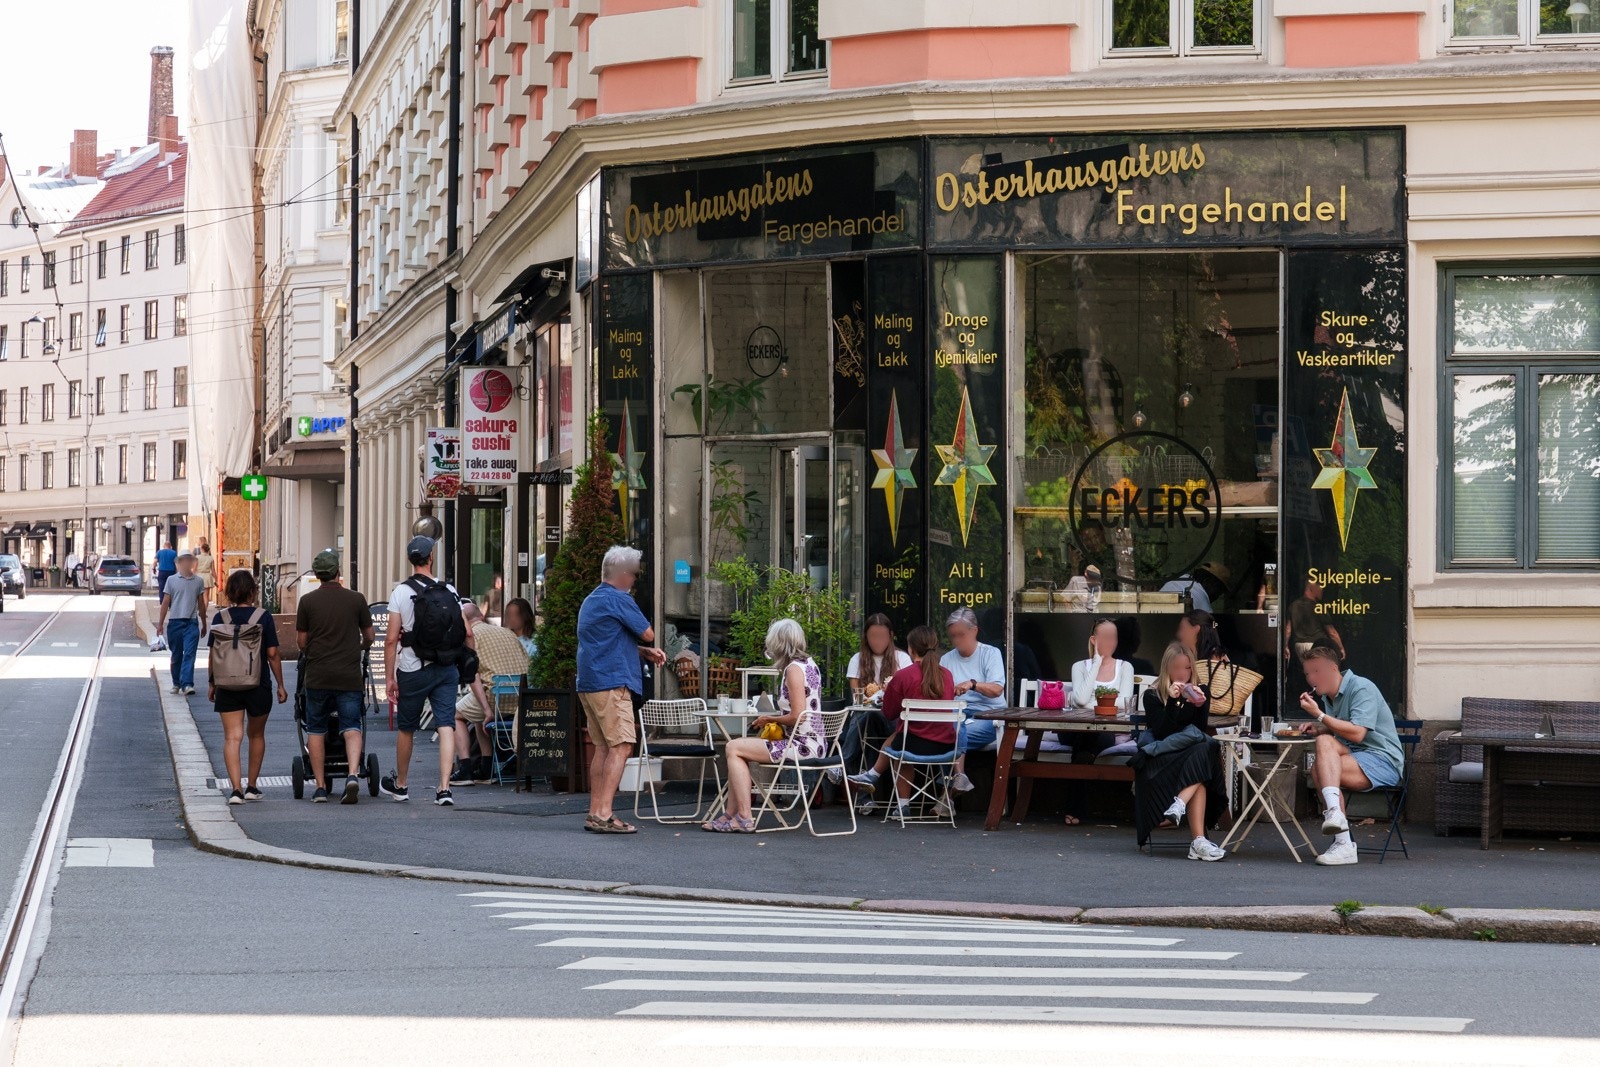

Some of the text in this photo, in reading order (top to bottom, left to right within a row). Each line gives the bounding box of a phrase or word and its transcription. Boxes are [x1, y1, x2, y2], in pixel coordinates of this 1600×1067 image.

[936, 142, 1206, 212] Osterhausgatens
[624, 168, 813, 243] Osterhausgatens
[1116, 186, 1347, 234] Fargehandel
[764, 210, 905, 244] Fargehandel
[874, 313, 913, 332] Maling
[944, 312, 989, 332] Droge
[1321, 310, 1375, 327] Skure-
[609, 328, 643, 347] Maling
[887, 334, 901, 348] og
[959, 331, 976, 347] og
[1336, 331, 1354, 348] og
[620, 348, 632, 360] og
[749, 344, 780, 360] ECKERS
[878, 352, 909, 368] Lakk
[935, 349, 998, 368] Kjemikalier
[1297, 350, 1396, 367] Vaskeartikler
[612, 365, 639, 380] Lakk
[465, 416, 518, 433] sakura
[472, 434, 511, 451] sushi
[466, 457, 488, 469] Take
[491, 459, 517, 473] away
[1082, 487, 1211, 528] ECKERS
[875, 563, 916, 579] Pensler
[949, 563, 985, 579] Alt i
[1308, 568, 1392, 588] Sykepleie-
[885, 590, 906, 608] Lys
[940, 588, 993, 608] Farger
[1314, 599, 1371, 615] artikler
